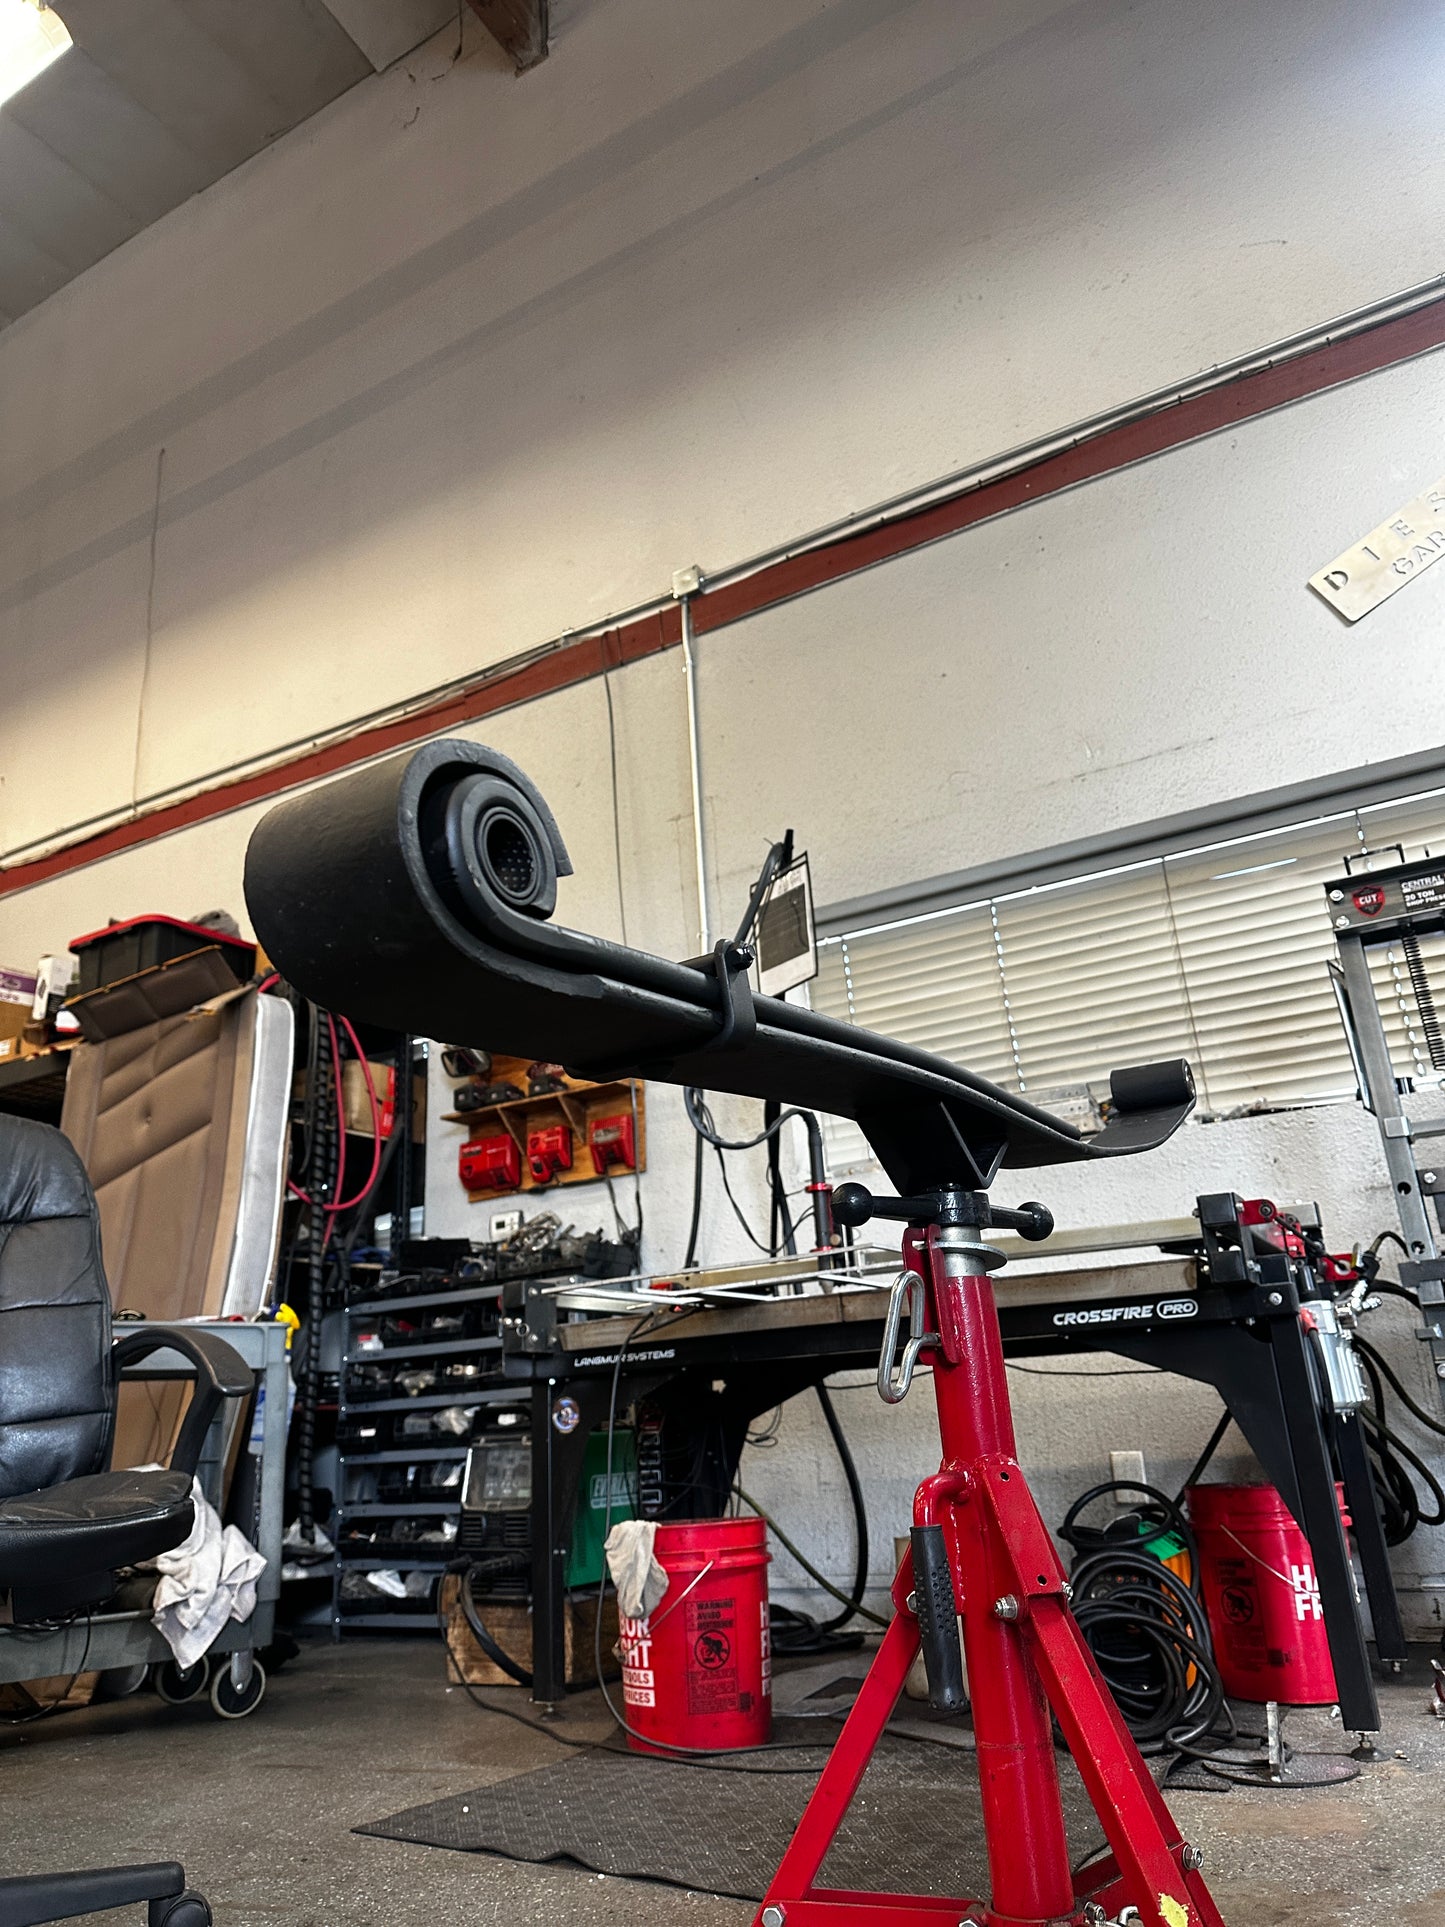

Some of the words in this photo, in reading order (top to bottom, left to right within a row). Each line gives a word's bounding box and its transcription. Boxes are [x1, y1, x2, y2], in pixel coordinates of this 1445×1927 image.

[1359, 893, 1378, 906] CUT
[1417, 889, 1435, 899] TON
[1053, 1305, 1154, 1326] CROSSFIRE
[1163, 1303, 1193, 1315] PRO
[627, 1349, 675, 1362] SYSTEMS
